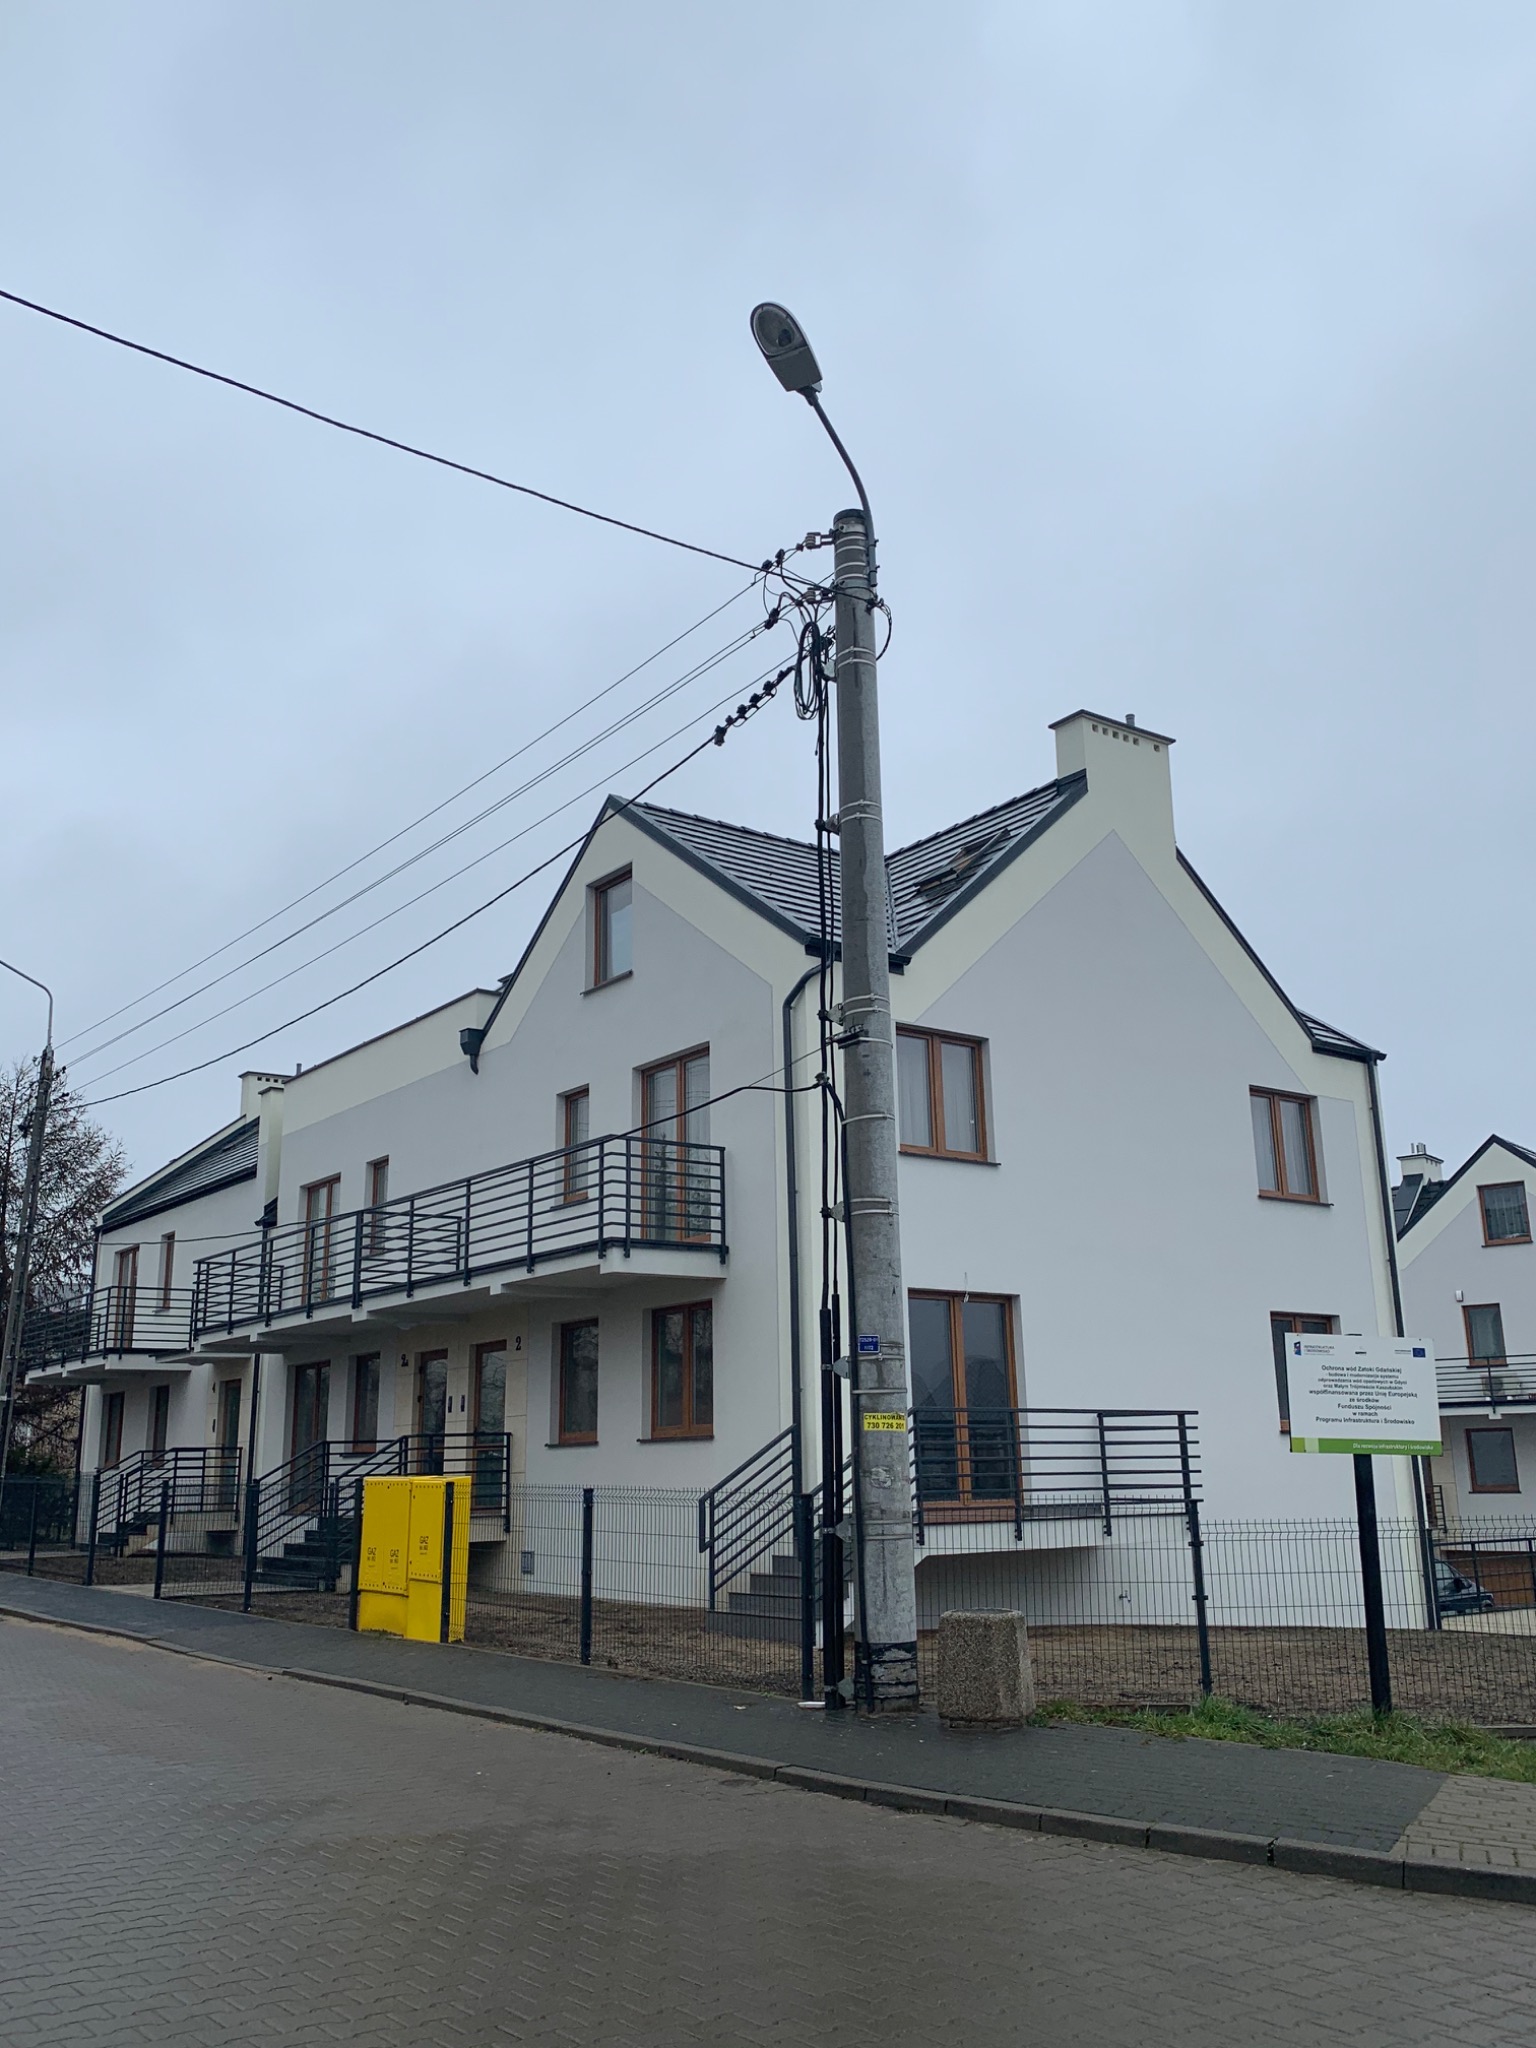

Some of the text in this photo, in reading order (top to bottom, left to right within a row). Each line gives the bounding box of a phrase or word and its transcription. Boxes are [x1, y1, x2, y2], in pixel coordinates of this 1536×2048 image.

[516, 1336, 522, 1351] 2
[420, 1536, 429, 1544] GAZ
[368, 1547, 376, 1555] GAZ
[390, 1549, 399, 1557] GAZ
